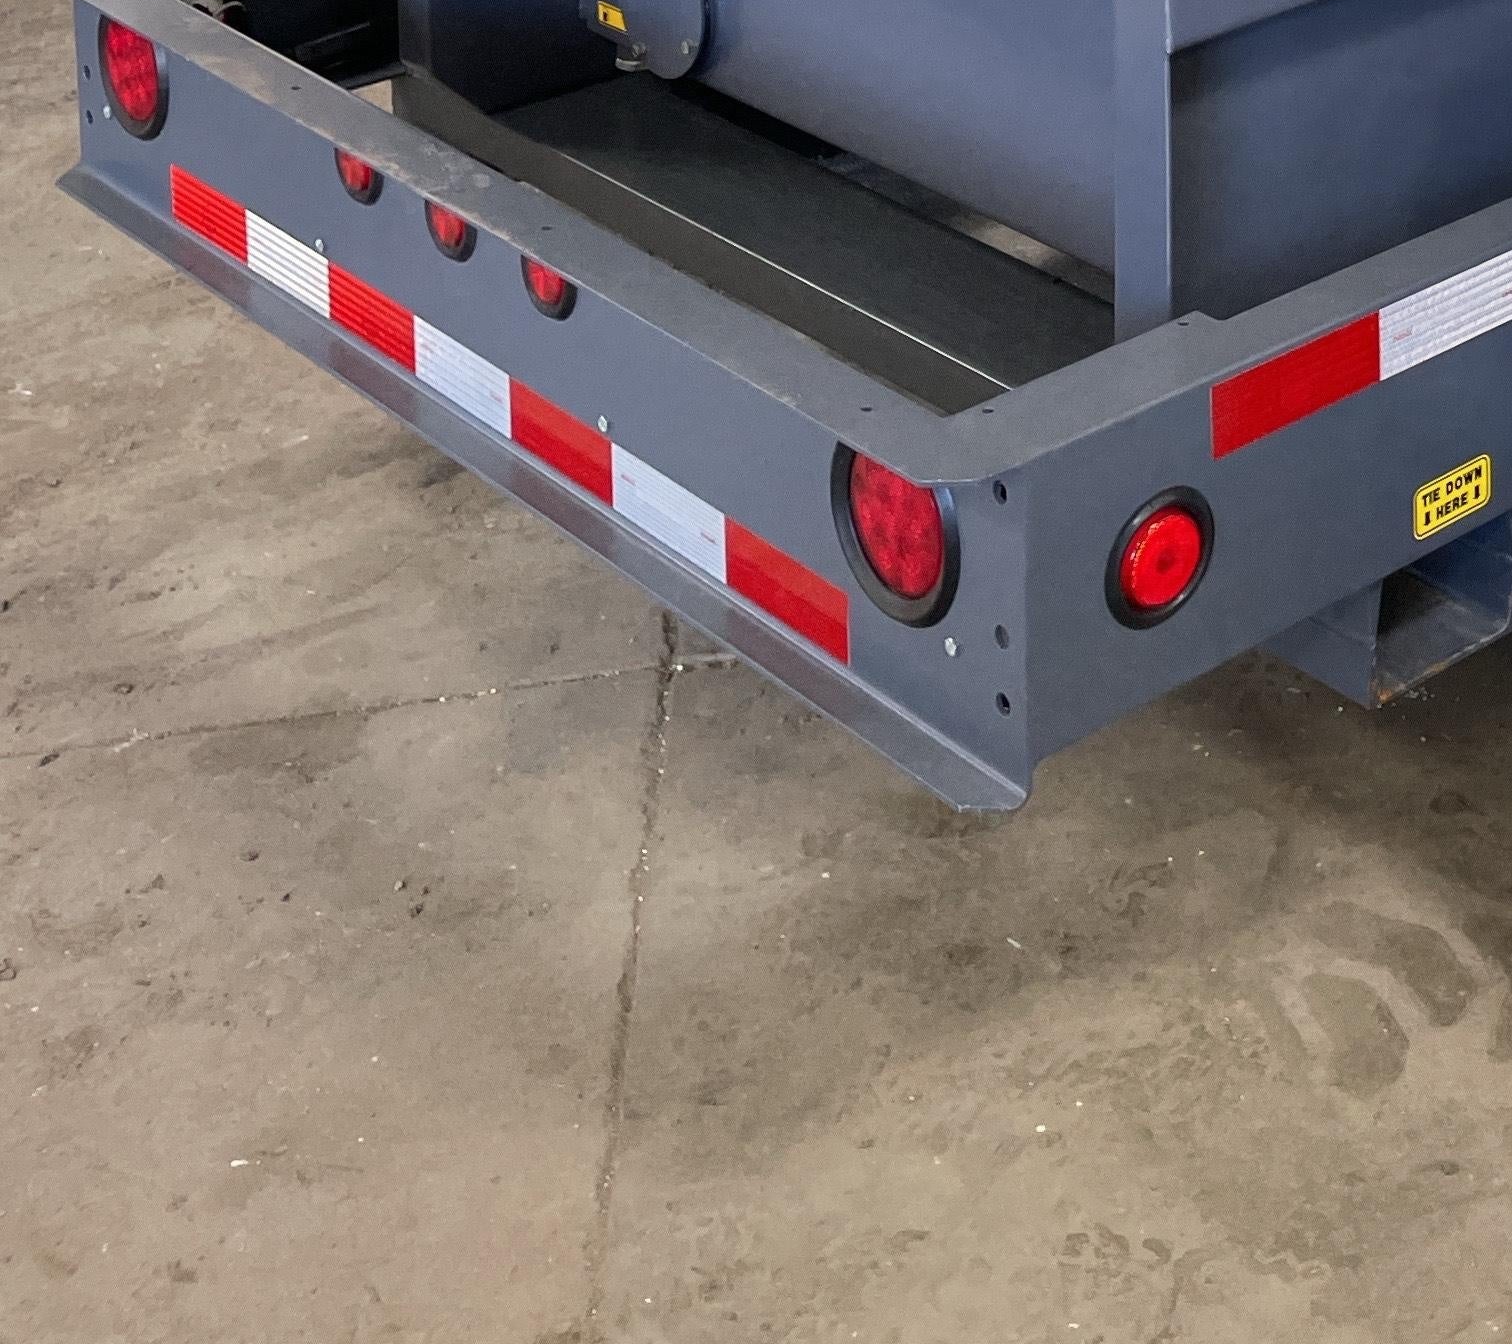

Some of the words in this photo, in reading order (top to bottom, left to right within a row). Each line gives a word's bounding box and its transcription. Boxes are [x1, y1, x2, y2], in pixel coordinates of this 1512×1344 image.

[1422, 487, 1441, 507] TIE
[1446, 465, 1482, 495] DOWN
[1436, 492, 1468, 520] HERE
